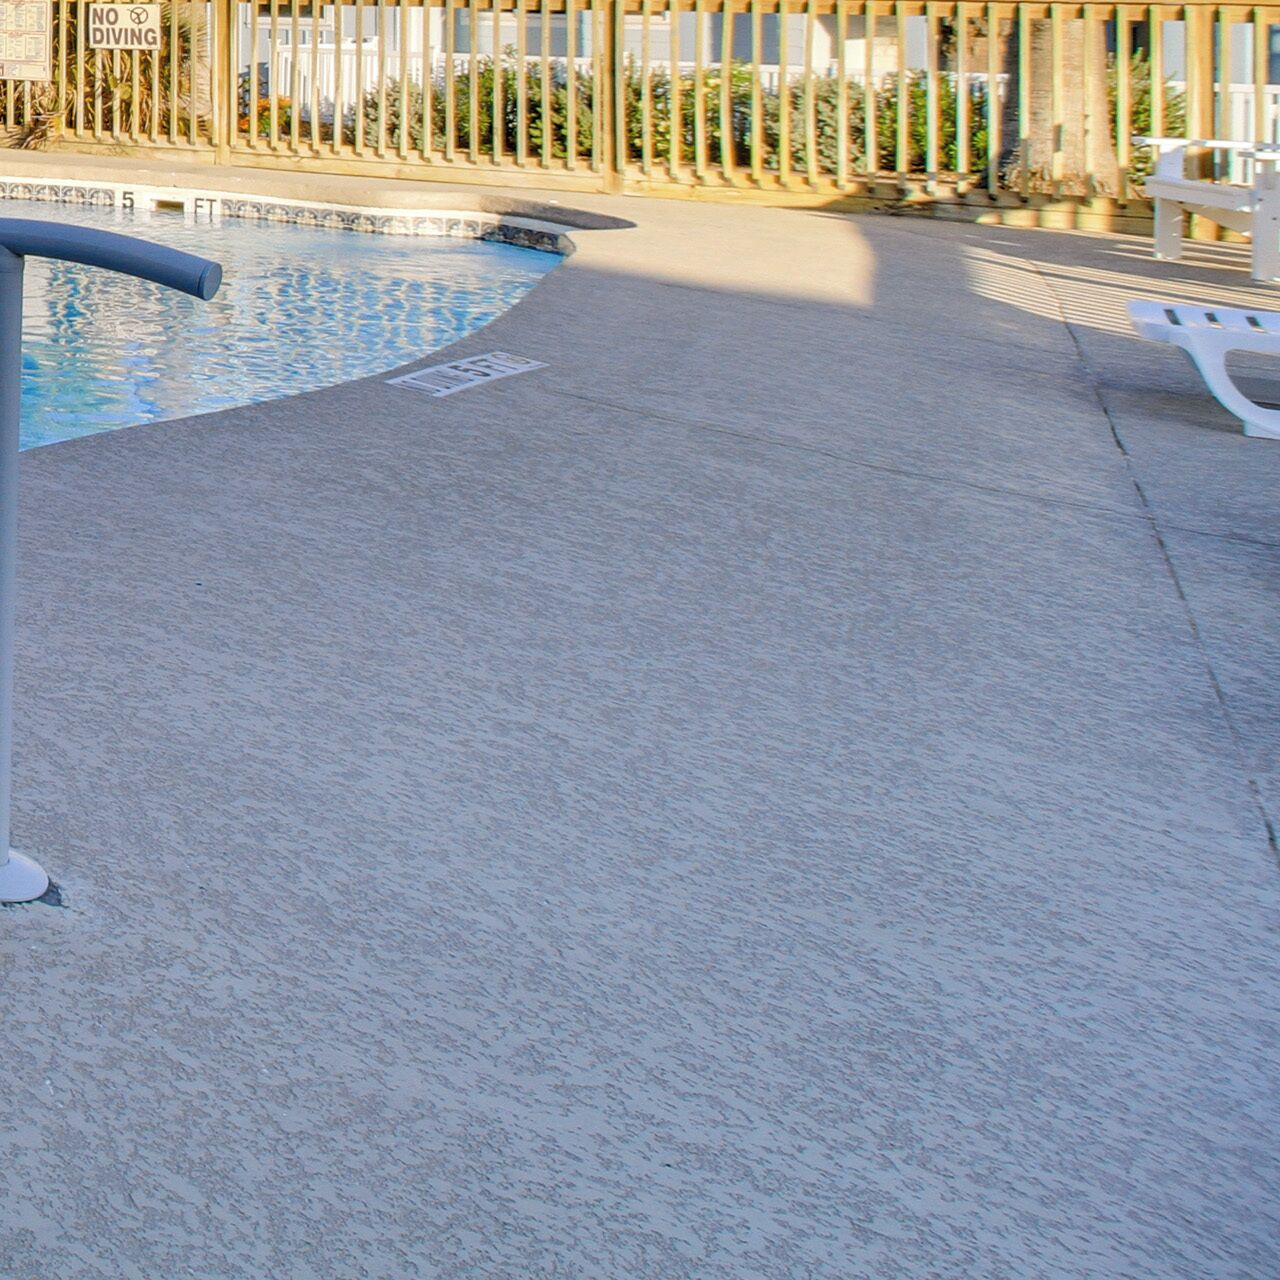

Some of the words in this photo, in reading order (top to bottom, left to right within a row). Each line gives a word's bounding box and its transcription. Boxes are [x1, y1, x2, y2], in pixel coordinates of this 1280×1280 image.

[92, 8, 118, 25] NO
[92, 27, 158, 46] DIVING
[122, 192, 134, 208] 5
[194, 198, 217, 215] FT
